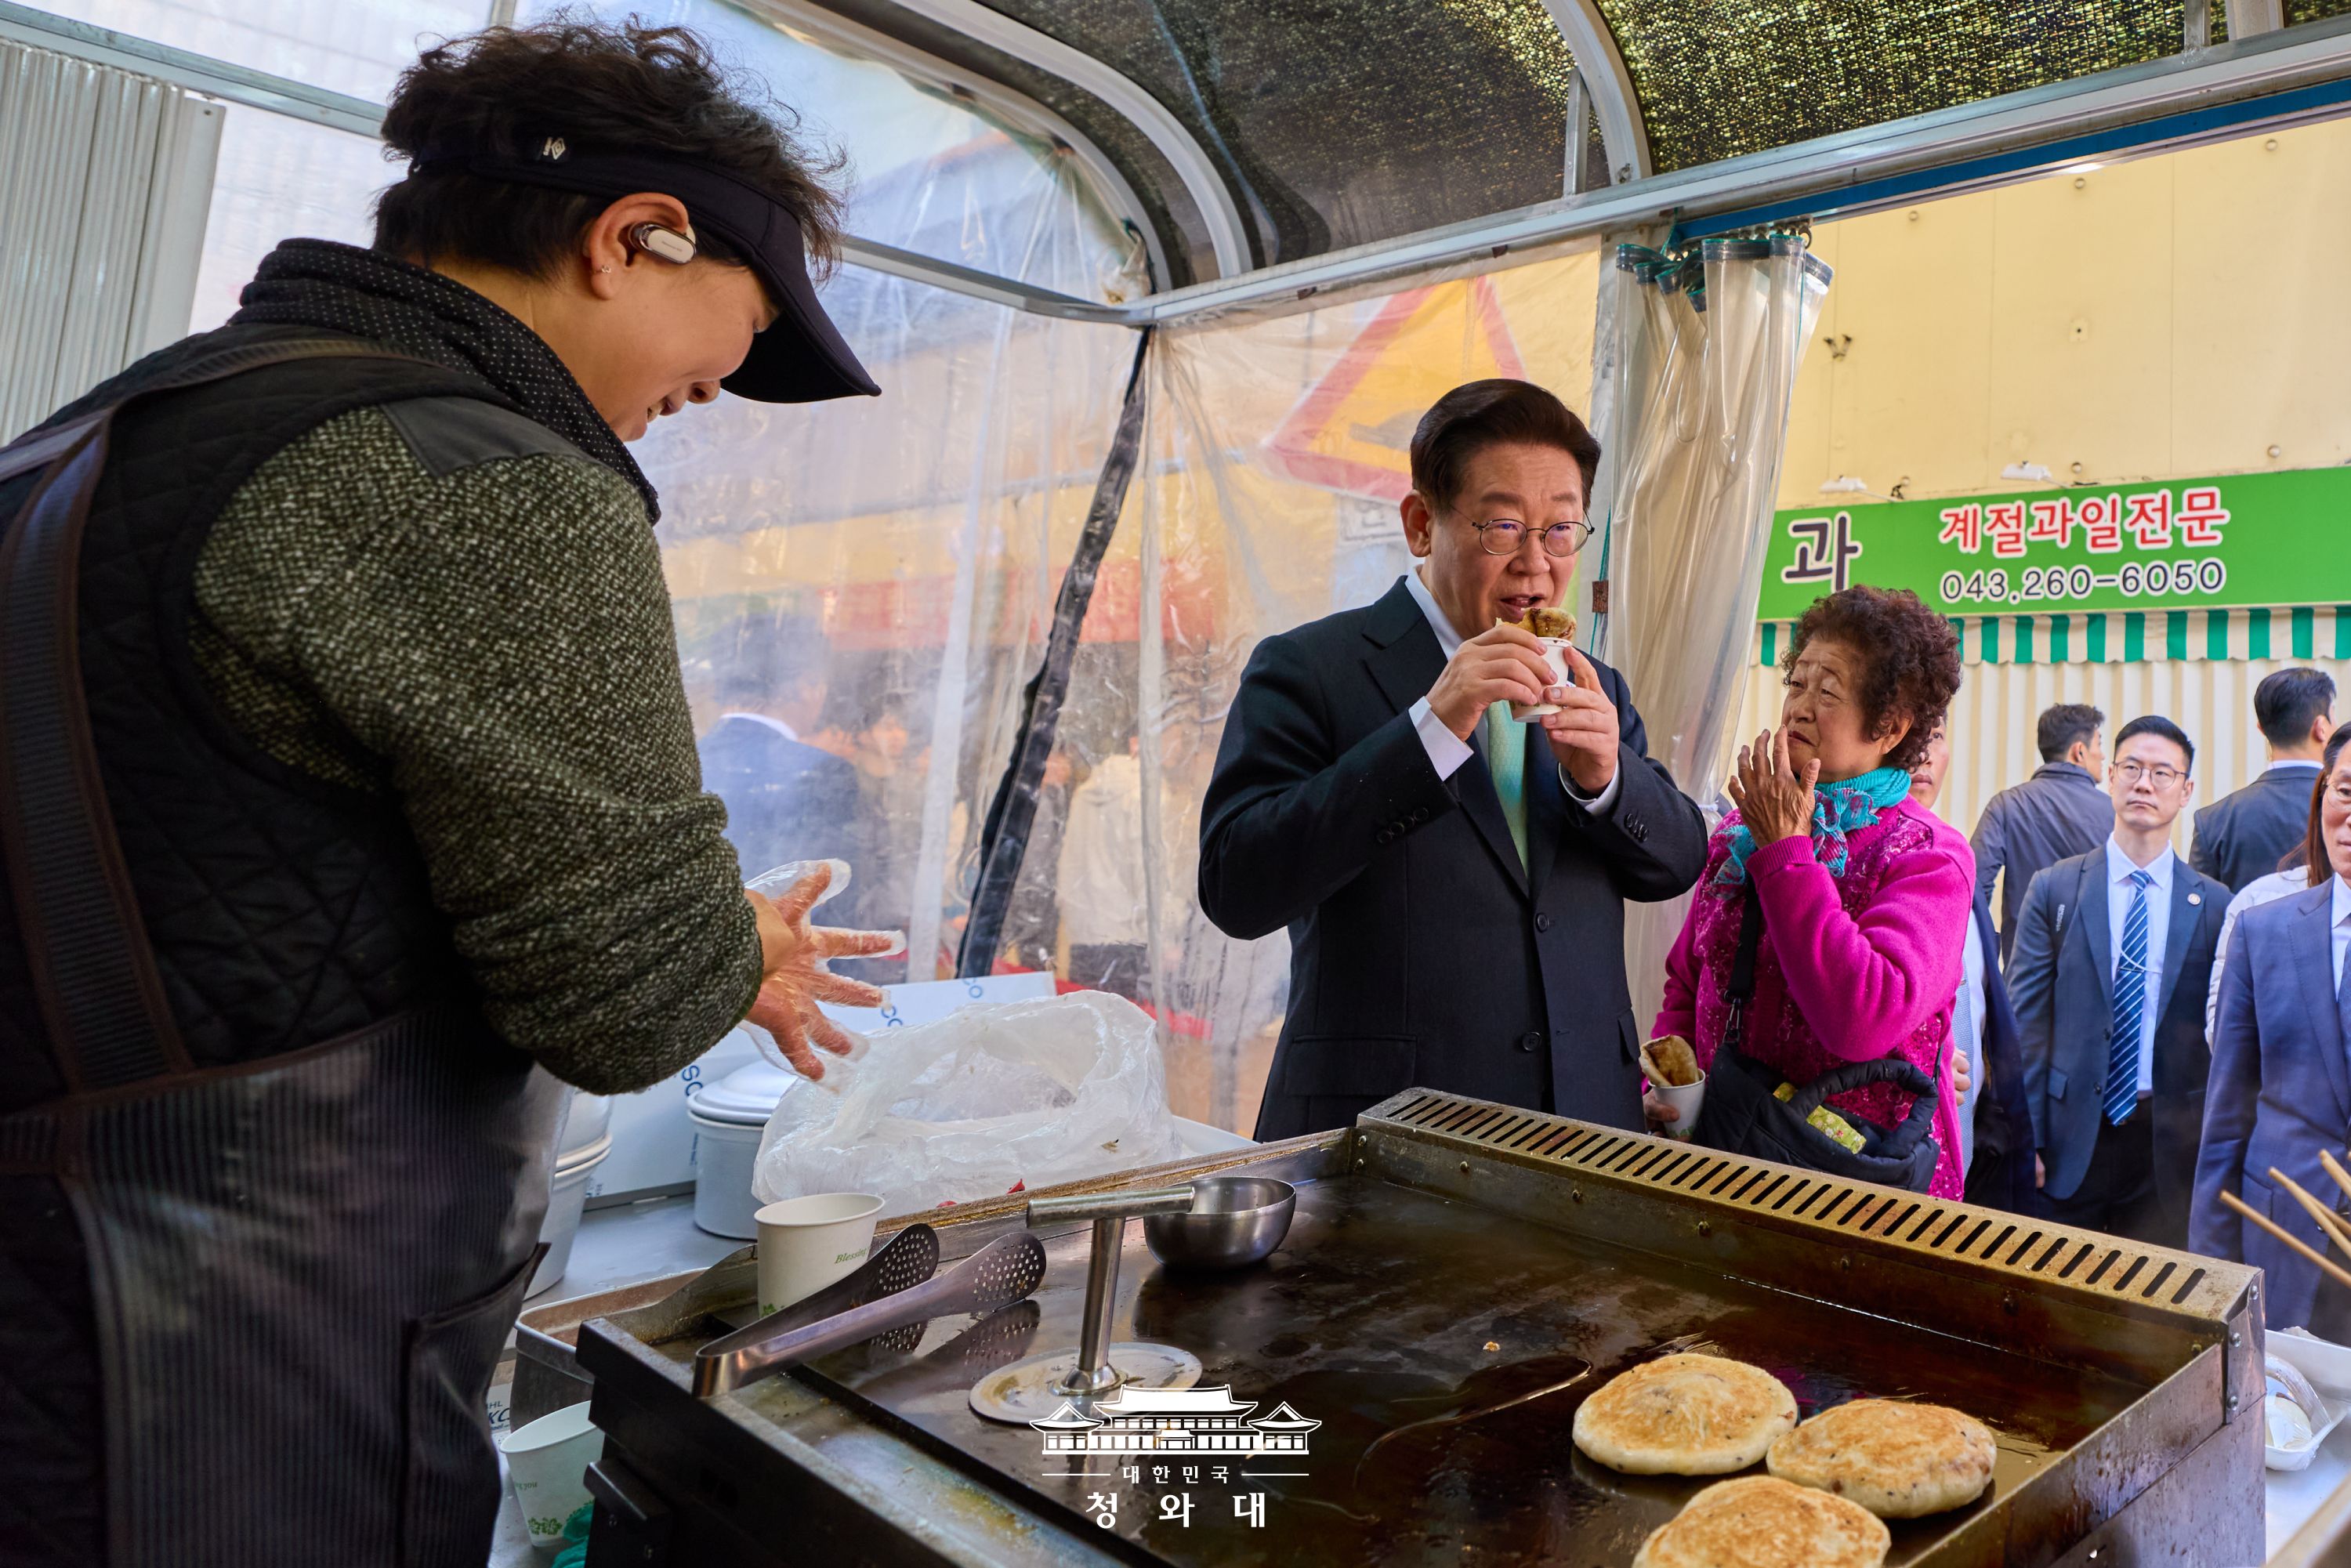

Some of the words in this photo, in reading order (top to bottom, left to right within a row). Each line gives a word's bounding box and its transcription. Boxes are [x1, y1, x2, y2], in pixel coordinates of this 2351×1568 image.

[1783, 514, 1860, 592] 과
[1940, 487, 2229, 557] 계절과일전문
[1940, 557, 2226, 604] 043.260-6050
